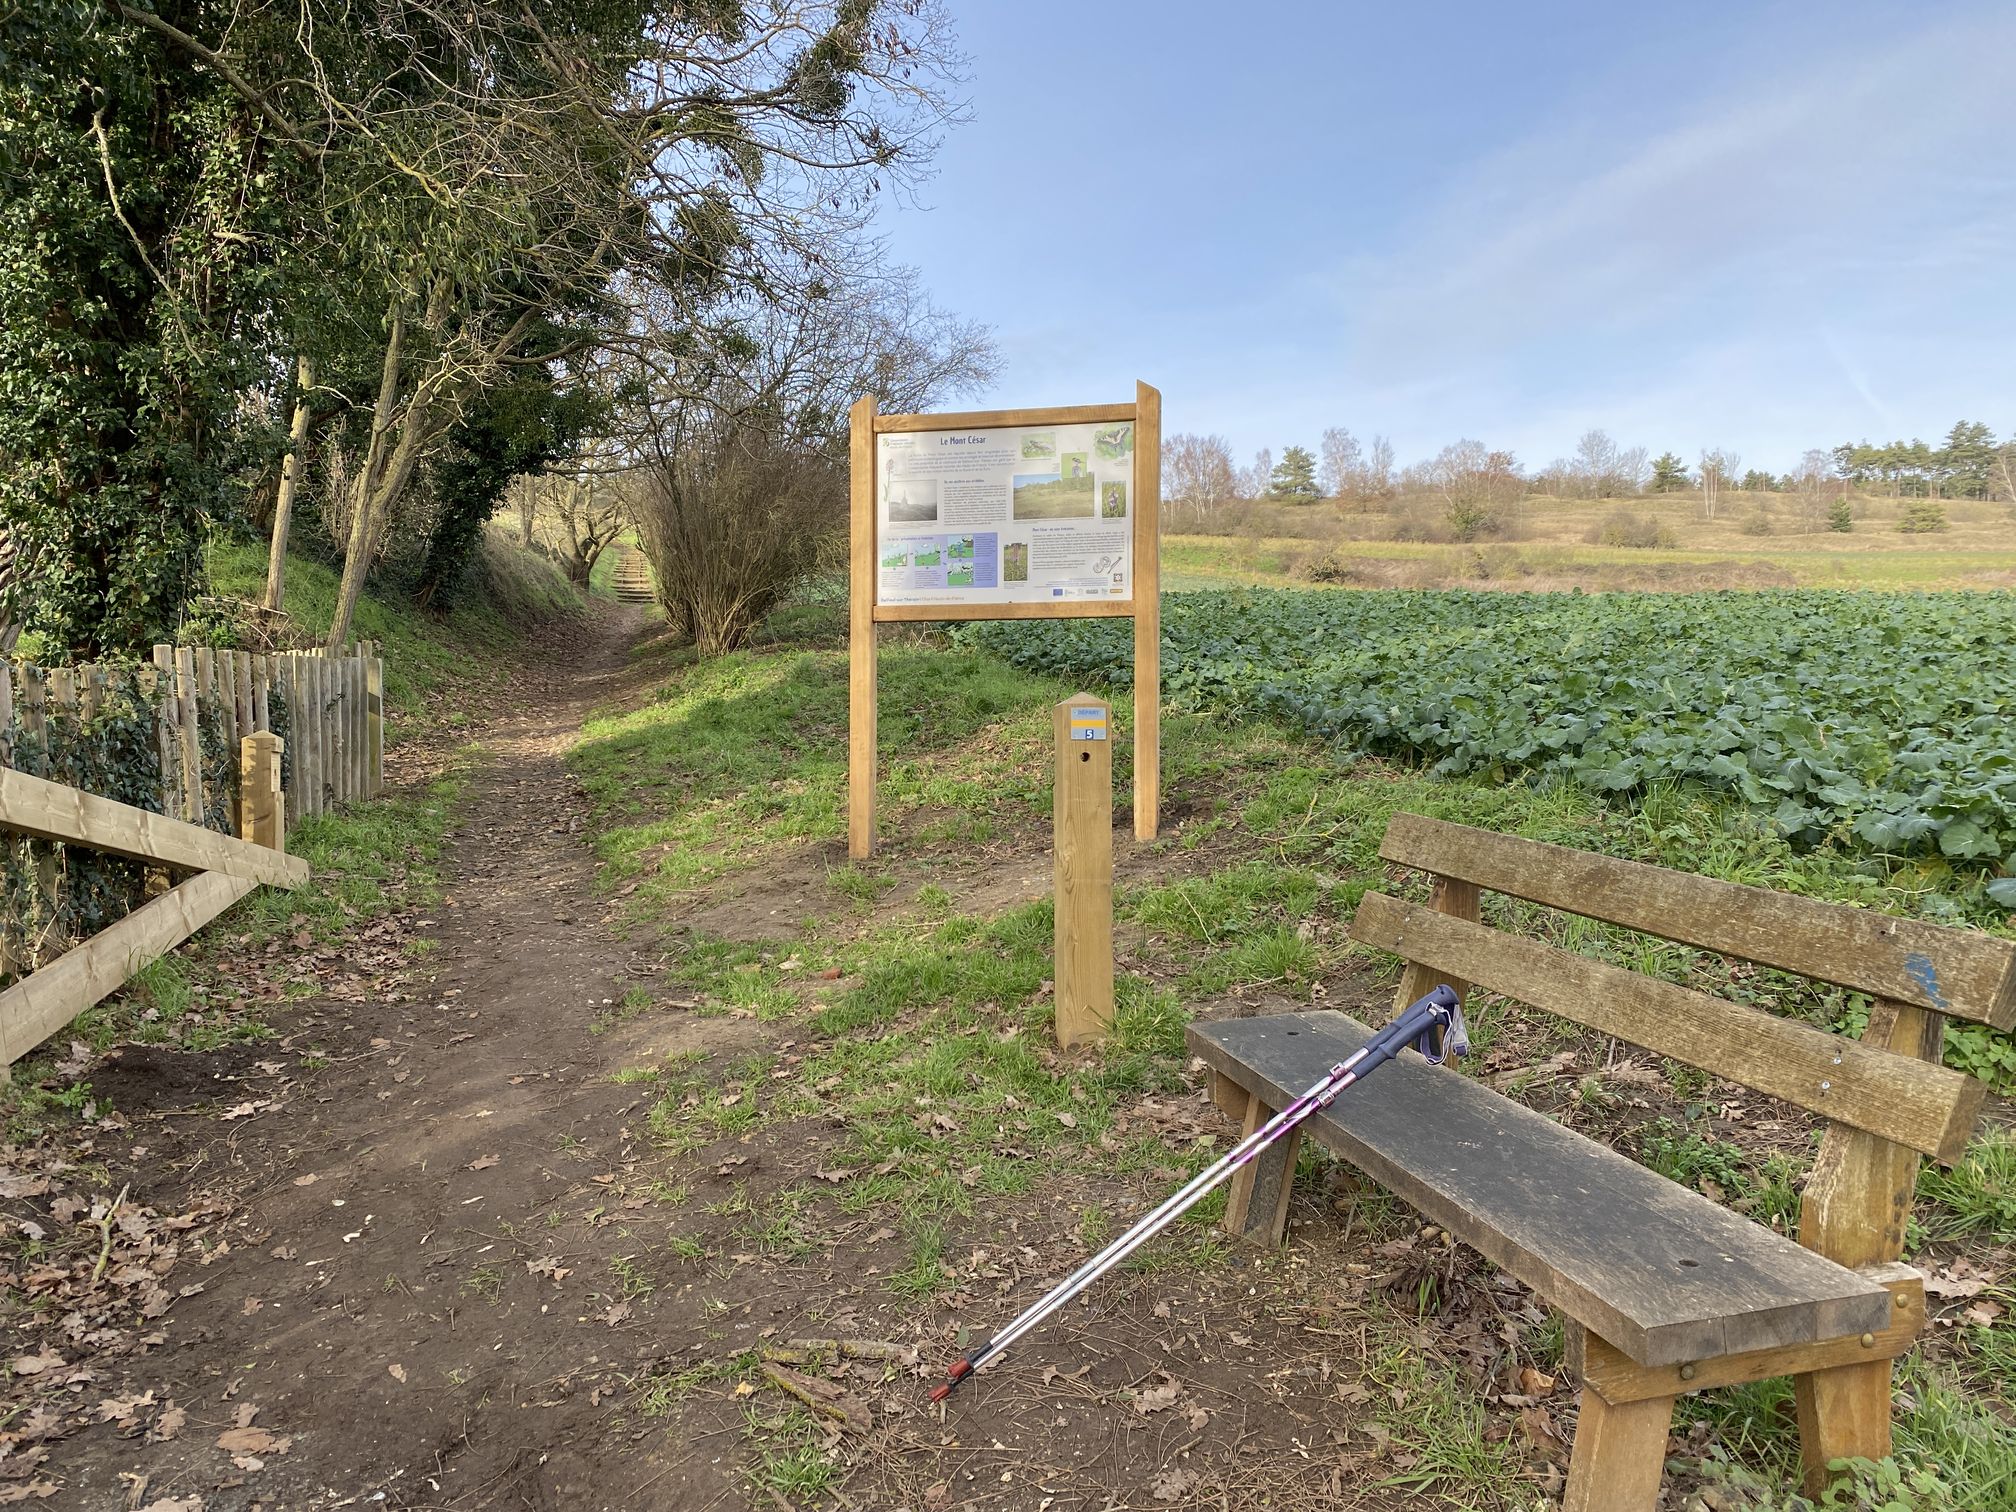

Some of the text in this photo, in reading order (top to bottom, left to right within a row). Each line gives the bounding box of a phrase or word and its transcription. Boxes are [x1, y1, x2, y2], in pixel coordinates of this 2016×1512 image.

[940, 435, 986, 446] Le Mont César
[1086, 730, 1093, 739] 5
